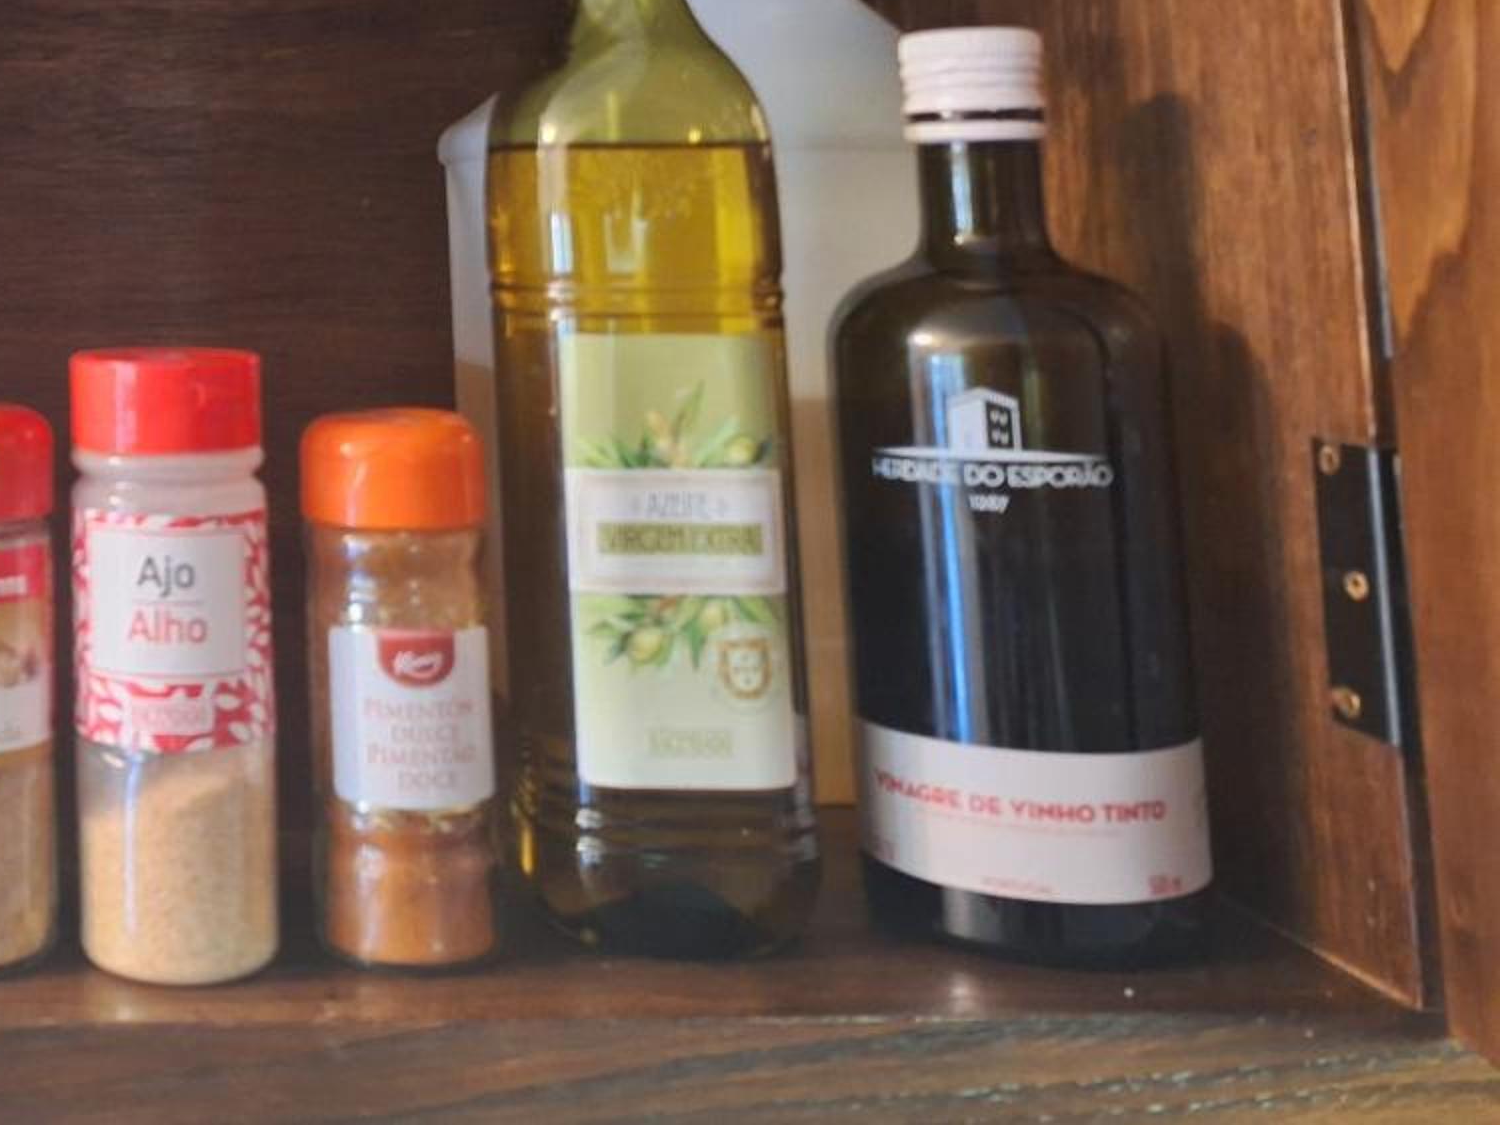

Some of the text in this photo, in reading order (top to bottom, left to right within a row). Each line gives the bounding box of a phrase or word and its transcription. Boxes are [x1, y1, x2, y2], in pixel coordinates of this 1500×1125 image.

[964, 463, 1006, 489] DO
[1007, 459, 1114, 489] ESPORÃO
[136, 555, 197, 598] Ajo
[127, 610, 209, 644] Alho
[875, 767, 1168, 824] VINAGRE DE VINHO TINTO
